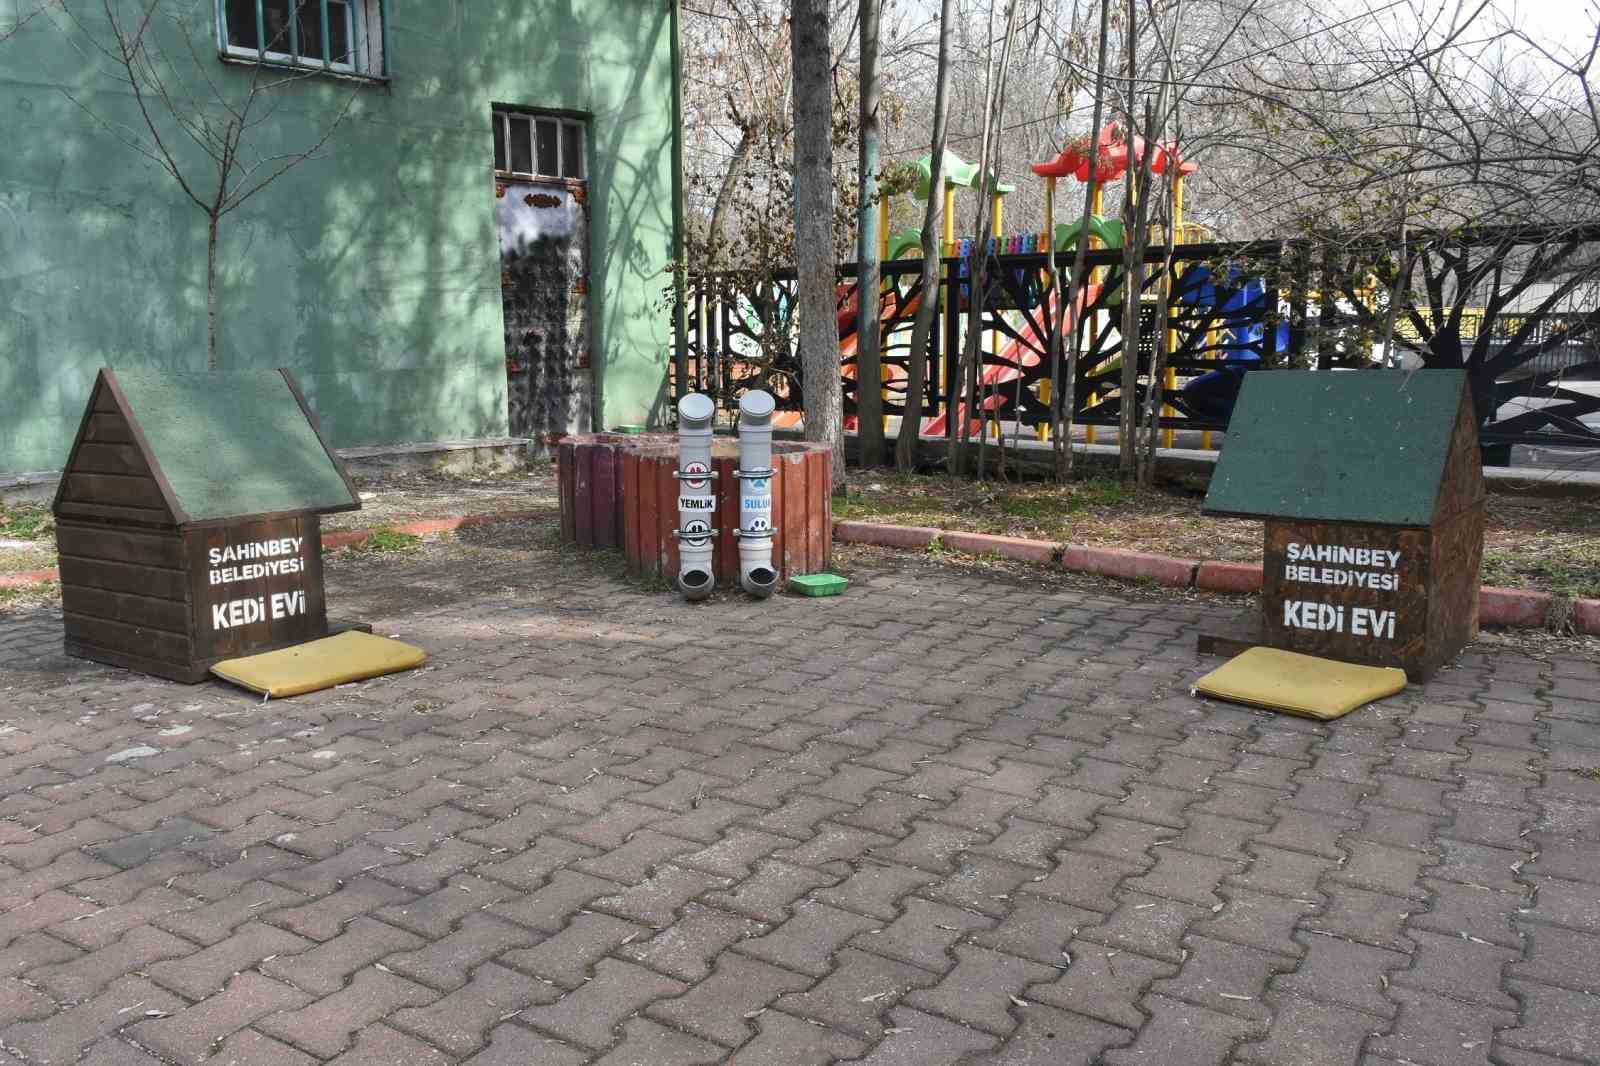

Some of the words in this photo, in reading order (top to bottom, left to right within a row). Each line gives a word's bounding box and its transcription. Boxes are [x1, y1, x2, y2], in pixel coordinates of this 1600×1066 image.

[680, 497, 713, 509] YEMLİK
[208, 537, 303, 567] ŞAHİNBEY
[1286, 542, 1401, 569] ŞAHİNBEY
[209, 557, 305, 585] BELEDİYESİ
[1285, 565, 1399, 591] BELEDİYESİ
[212, 596, 266, 630] KEDİ
[271, 590, 306, 620] EVİ
[1283, 599, 1344, 633] KEDİ
[1351, 607, 1396, 639] EVİ
